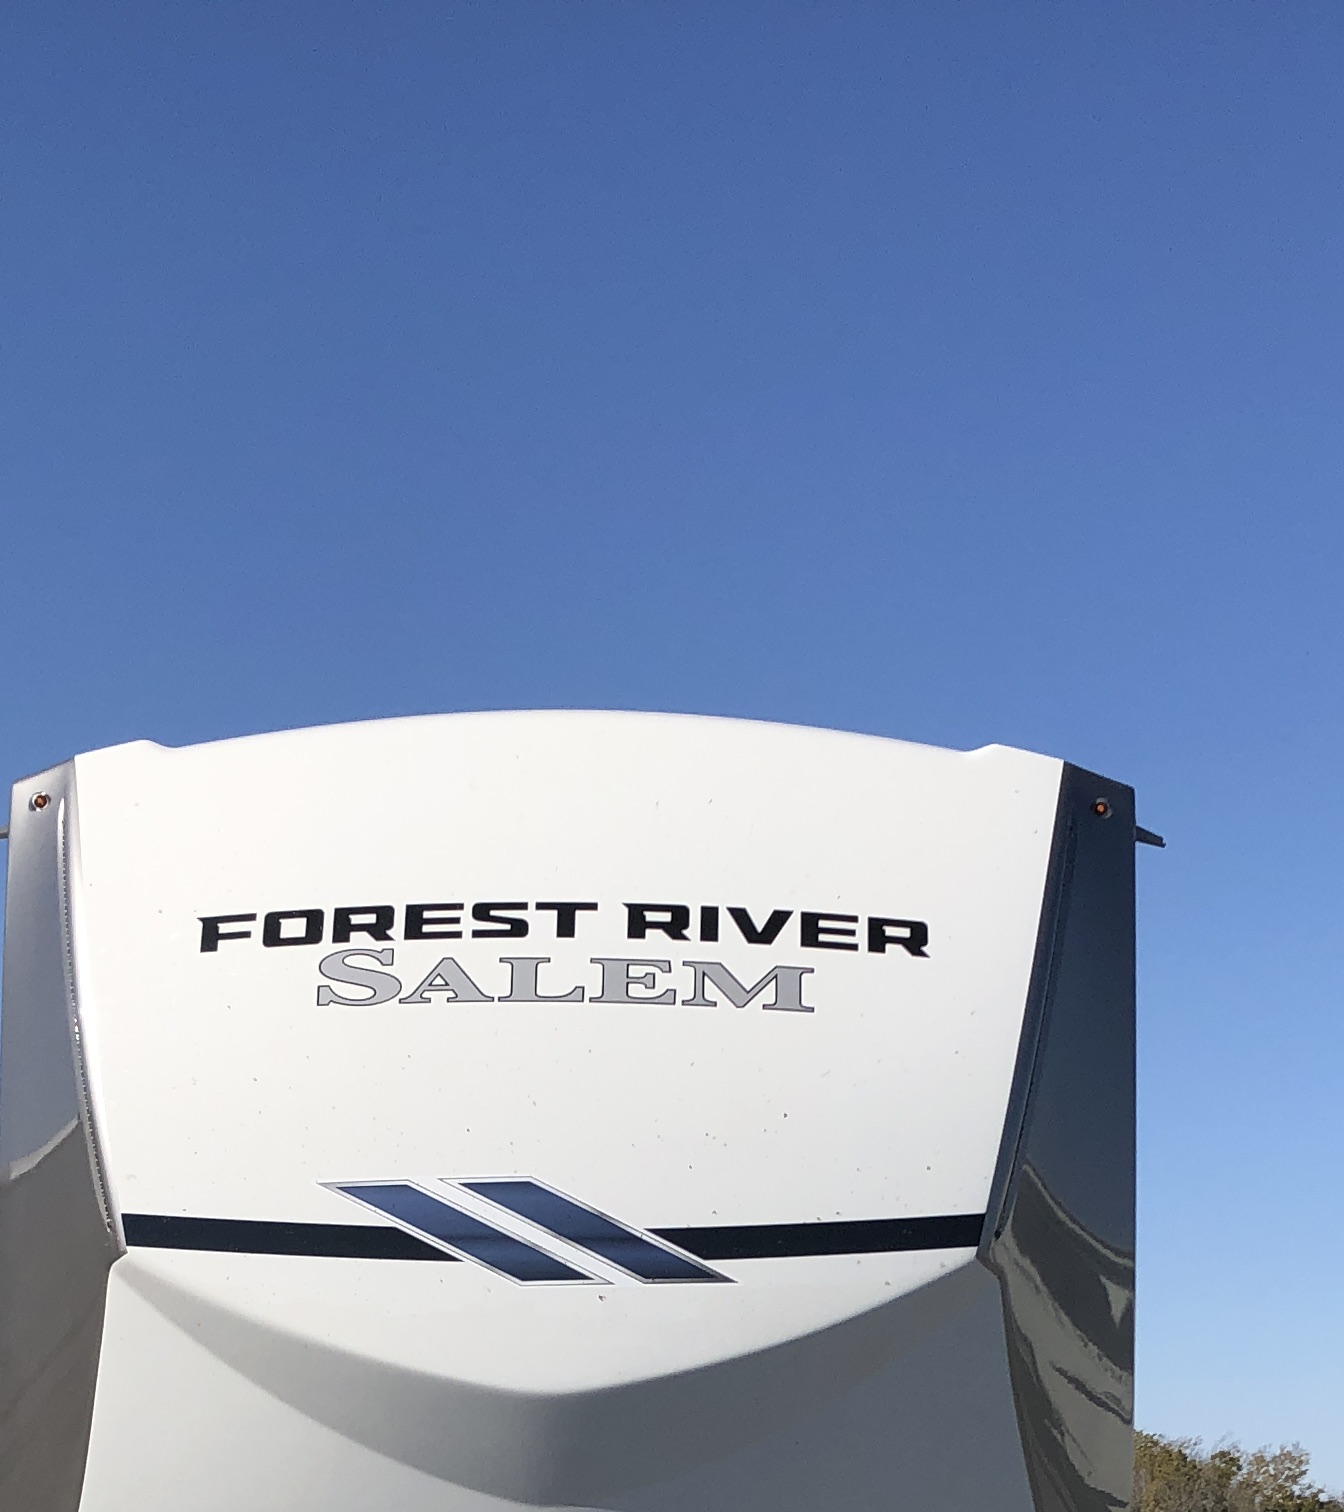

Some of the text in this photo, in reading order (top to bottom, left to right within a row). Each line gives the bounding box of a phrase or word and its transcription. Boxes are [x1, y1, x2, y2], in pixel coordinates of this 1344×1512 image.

[197, 902, 931, 958] FOREST RIVER
[317, 949, 815, 1013] SALEM
